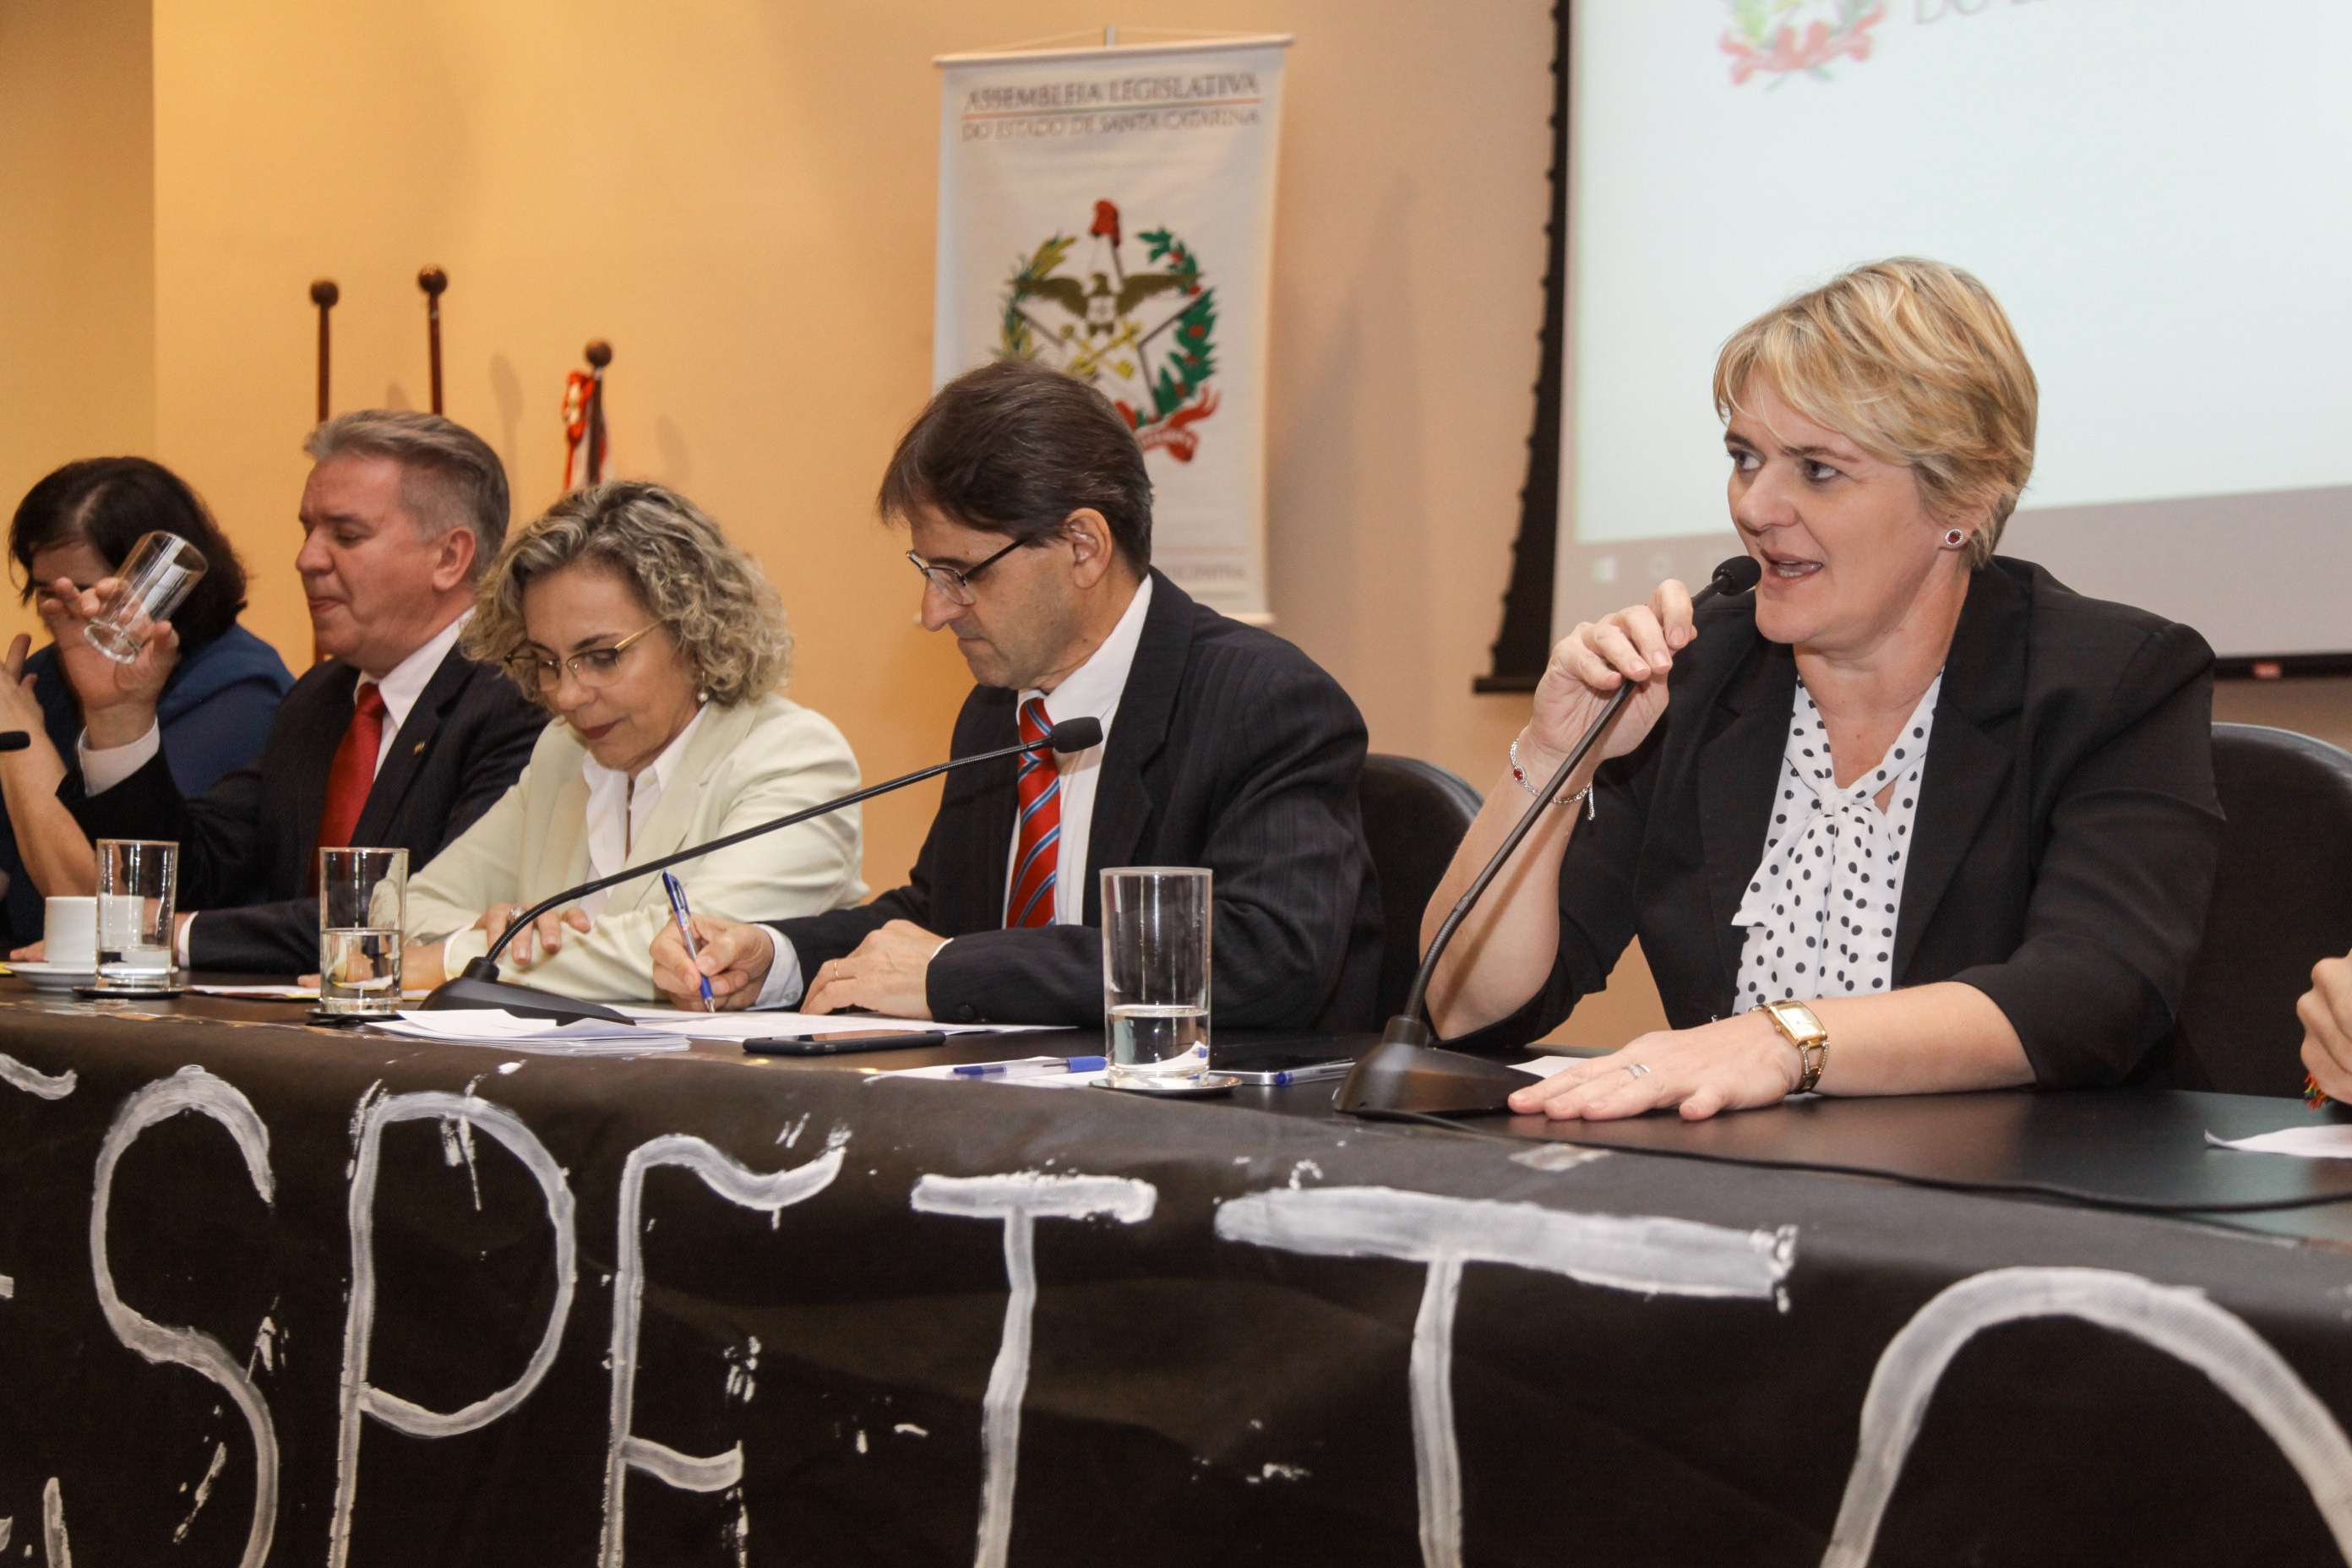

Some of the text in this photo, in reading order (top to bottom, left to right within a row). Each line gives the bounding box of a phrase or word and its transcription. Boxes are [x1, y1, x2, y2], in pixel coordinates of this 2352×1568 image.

[965, 72, 1259, 111] ASSEMBLEIA LEGISLATIVA
[961, 106, 1262, 141] DO ESTADO DE SANTA CATARINA
